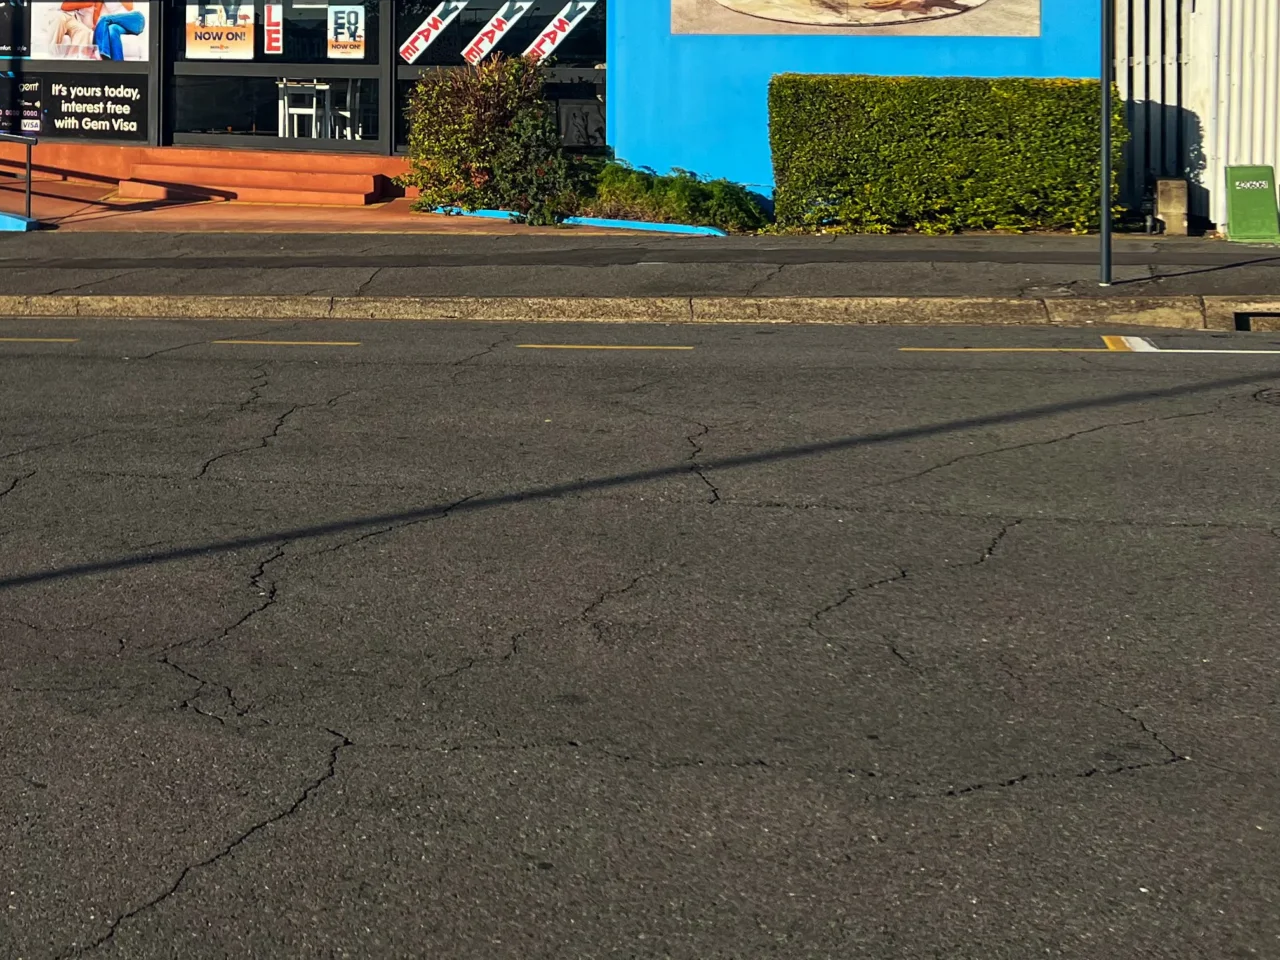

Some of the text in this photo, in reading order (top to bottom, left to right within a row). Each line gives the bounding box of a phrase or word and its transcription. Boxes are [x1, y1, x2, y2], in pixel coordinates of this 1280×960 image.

[194, 31, 246, 41] NOW ON!
[399, 16, 443, 61] SALE
[464, 17, 508, 63] SALE
[70, 86, 102, 99] yours
[104, 84, 141, 101] today,
[61, 100, 131, 115] interest free
[22, 121, 39, 129] VISA
[54, 116, 137, 132] with Gem Visa
